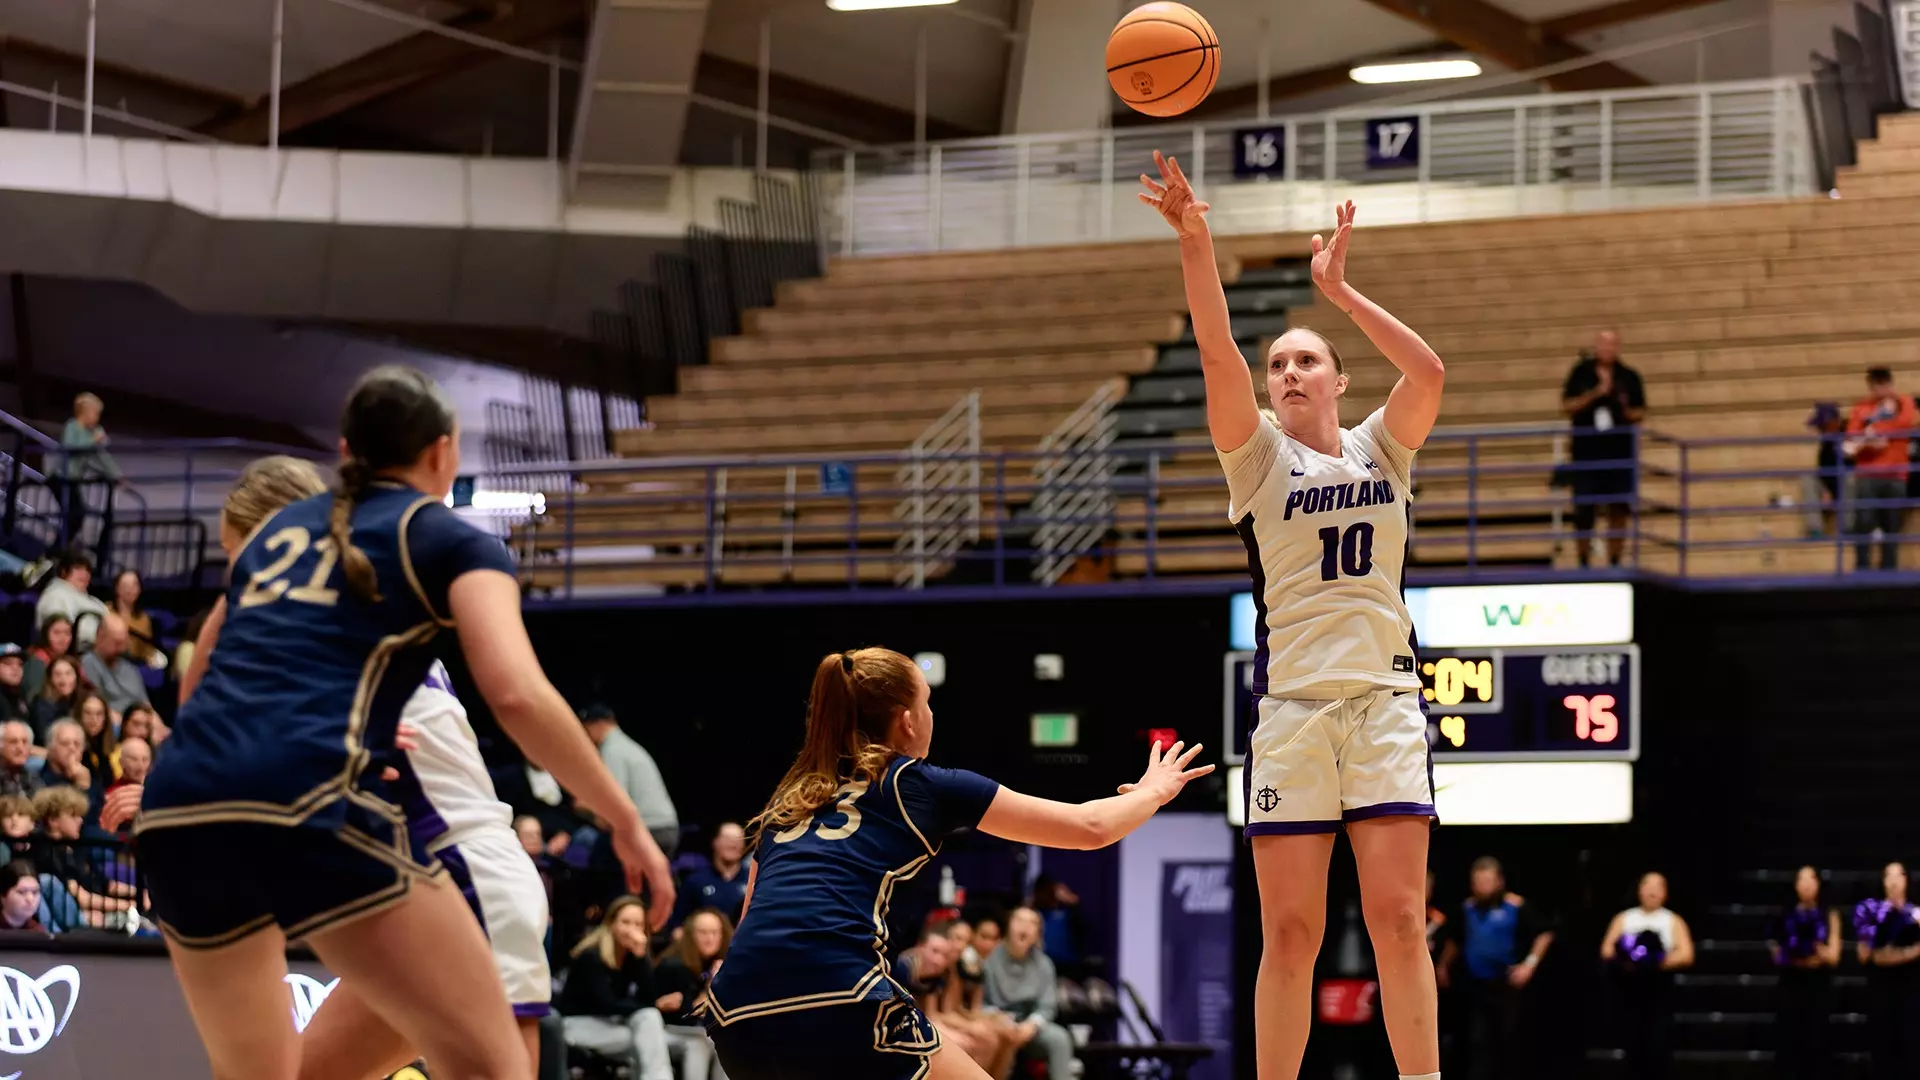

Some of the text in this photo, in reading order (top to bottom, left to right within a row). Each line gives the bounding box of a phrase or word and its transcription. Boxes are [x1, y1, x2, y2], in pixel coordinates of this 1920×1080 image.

[1243, 132, 1278, 167] 16
[1377, 122, 1412, 158] 17
[1283, 479, 1395, 521] PORTLAND
[239, 526, 340, 609] 21
[1318, 521, 1375, 582] 10
[1418, 657, 1493, 706] :04
[1541, 654, 1622, 686] GUEST
[1439, 716, 1466, 748] 4
[1563, 694, 1619, 743] 75
